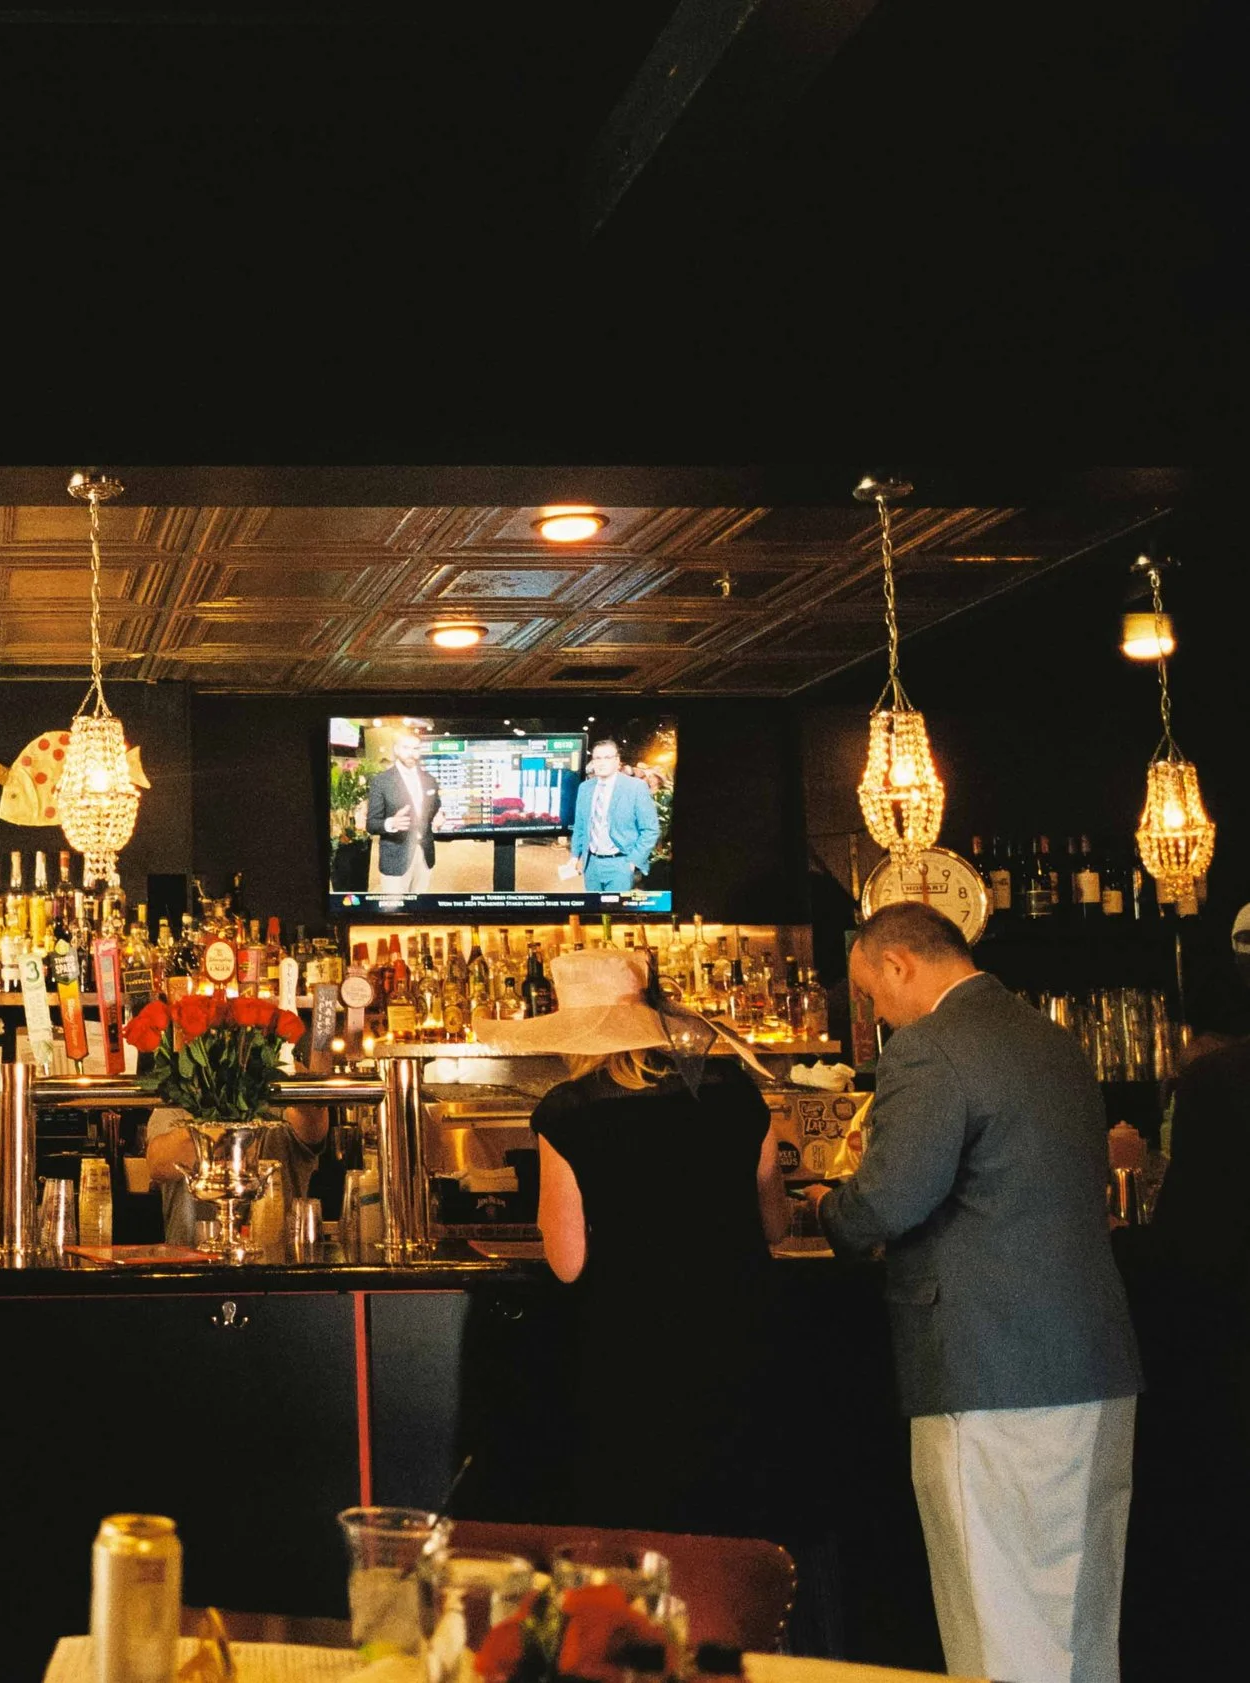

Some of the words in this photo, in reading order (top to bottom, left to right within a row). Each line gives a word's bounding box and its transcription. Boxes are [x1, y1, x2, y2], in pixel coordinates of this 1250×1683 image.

[942, 869, 951, 881] 9
[958, 886, 967, 899] 8
[960, 910, 970, 923] 7
[26, 960, 40, 982] 3
